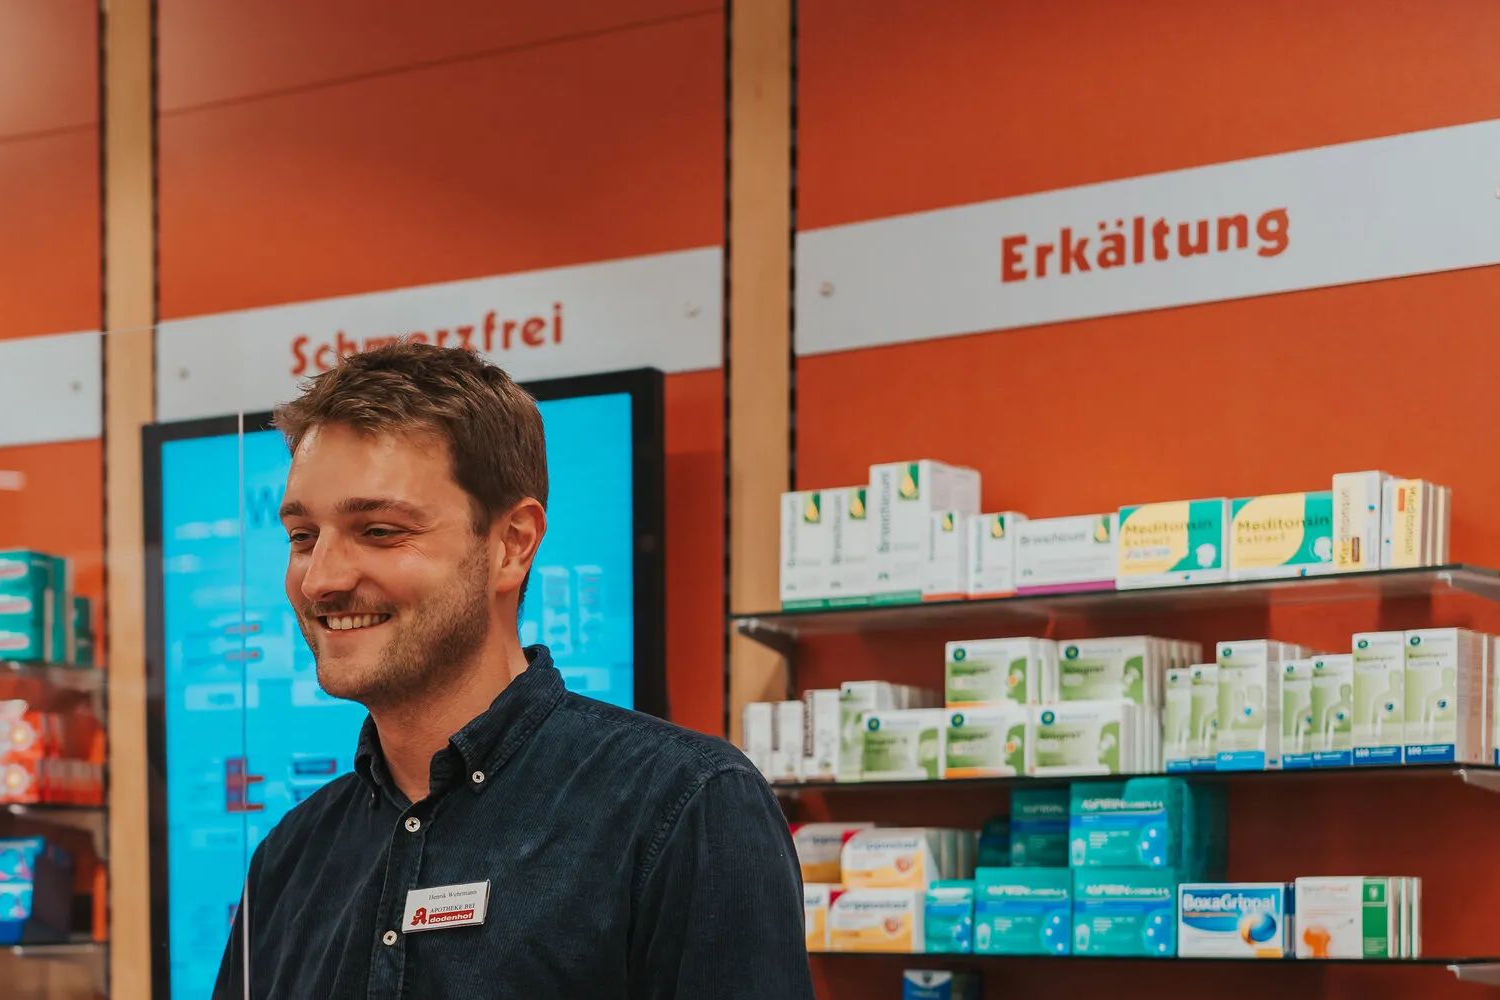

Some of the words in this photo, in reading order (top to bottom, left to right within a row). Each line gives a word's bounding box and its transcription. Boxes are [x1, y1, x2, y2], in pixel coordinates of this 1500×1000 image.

[1001, 207, 1289, 284] Erkältung
[1124, 519, 1213, 535] Meditonsin
[1237, 515, 1330, 532] Meditonsin
[430, 904, 463, 914] APOTHEKE
[1183, 892, 1276, 912] BoxaGrippal
[429, 913, 473, 924] dodenhof
